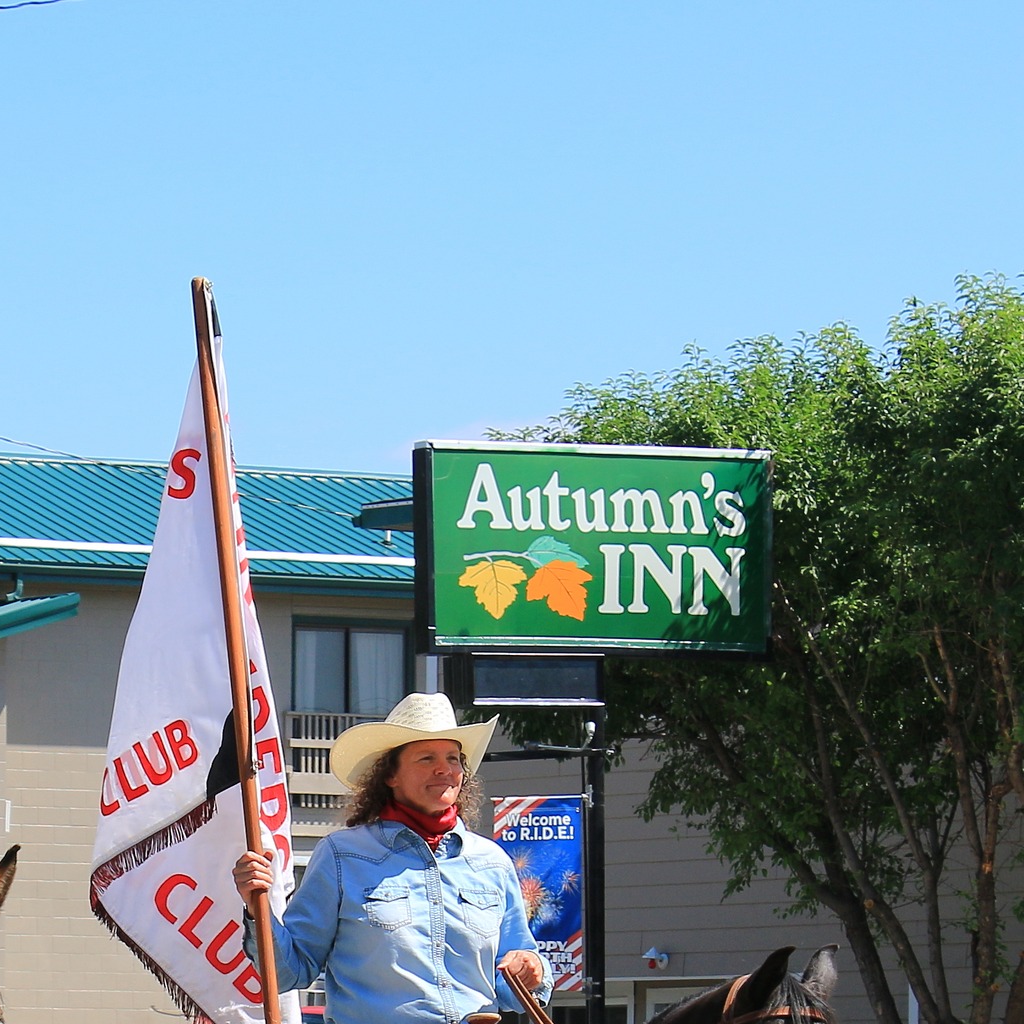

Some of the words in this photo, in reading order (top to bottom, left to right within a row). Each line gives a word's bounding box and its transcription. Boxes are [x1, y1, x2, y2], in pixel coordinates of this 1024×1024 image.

[457, 461, 747, 538] Autumn's
[598, 543, 746, 617] INN
[100, 719, 198, 816] CLUB
[501, 828, 517, 842] to
[505, 812, 571, 827] Welcome
[154, 873, 264, 1004] CLUB
